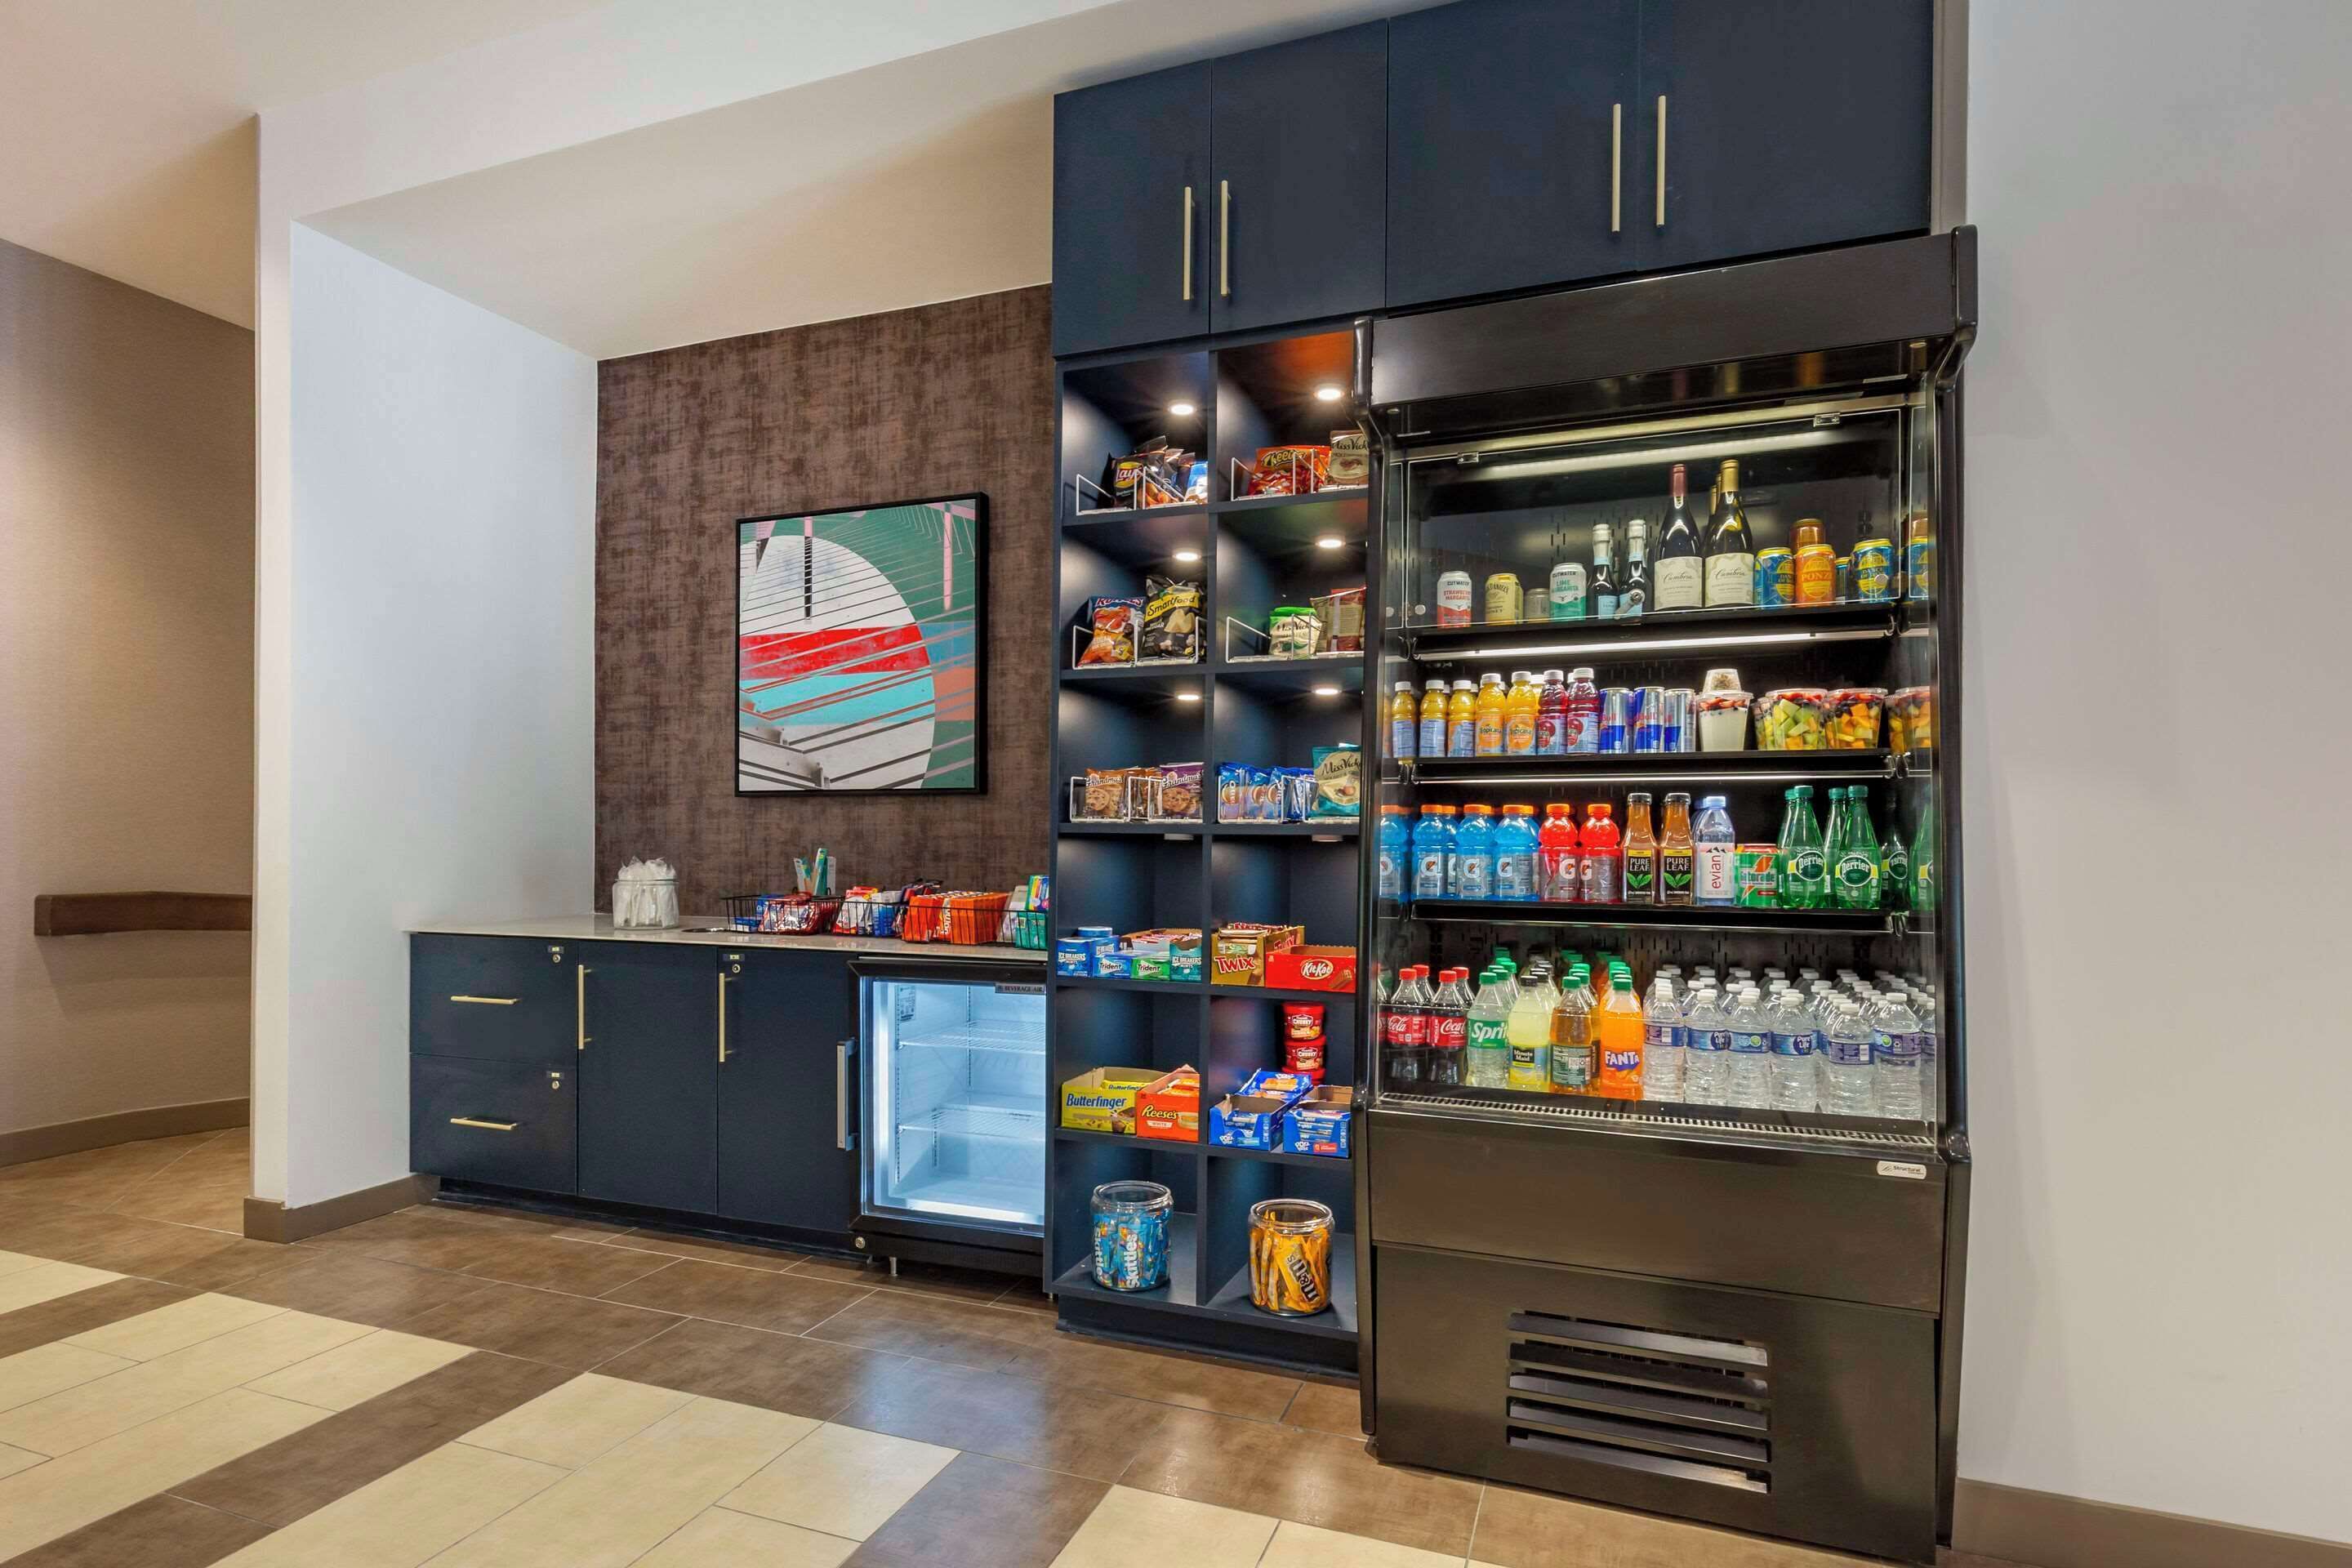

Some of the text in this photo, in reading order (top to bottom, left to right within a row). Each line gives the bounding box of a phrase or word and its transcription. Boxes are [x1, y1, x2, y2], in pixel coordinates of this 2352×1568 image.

[1147, 595, 1196, 617] Smartfood
[1710, 855, 1722, 889] evian
[1798, 857, 1824, 874] Perrier
[1842, 861, 1870, 880] Perrier
[1605, 1050, 1640, 1066] FANTA
[1066, 1094, 1127, 1109] Butterfinger
[1124, 1234, 1140, 1288] Skittles
